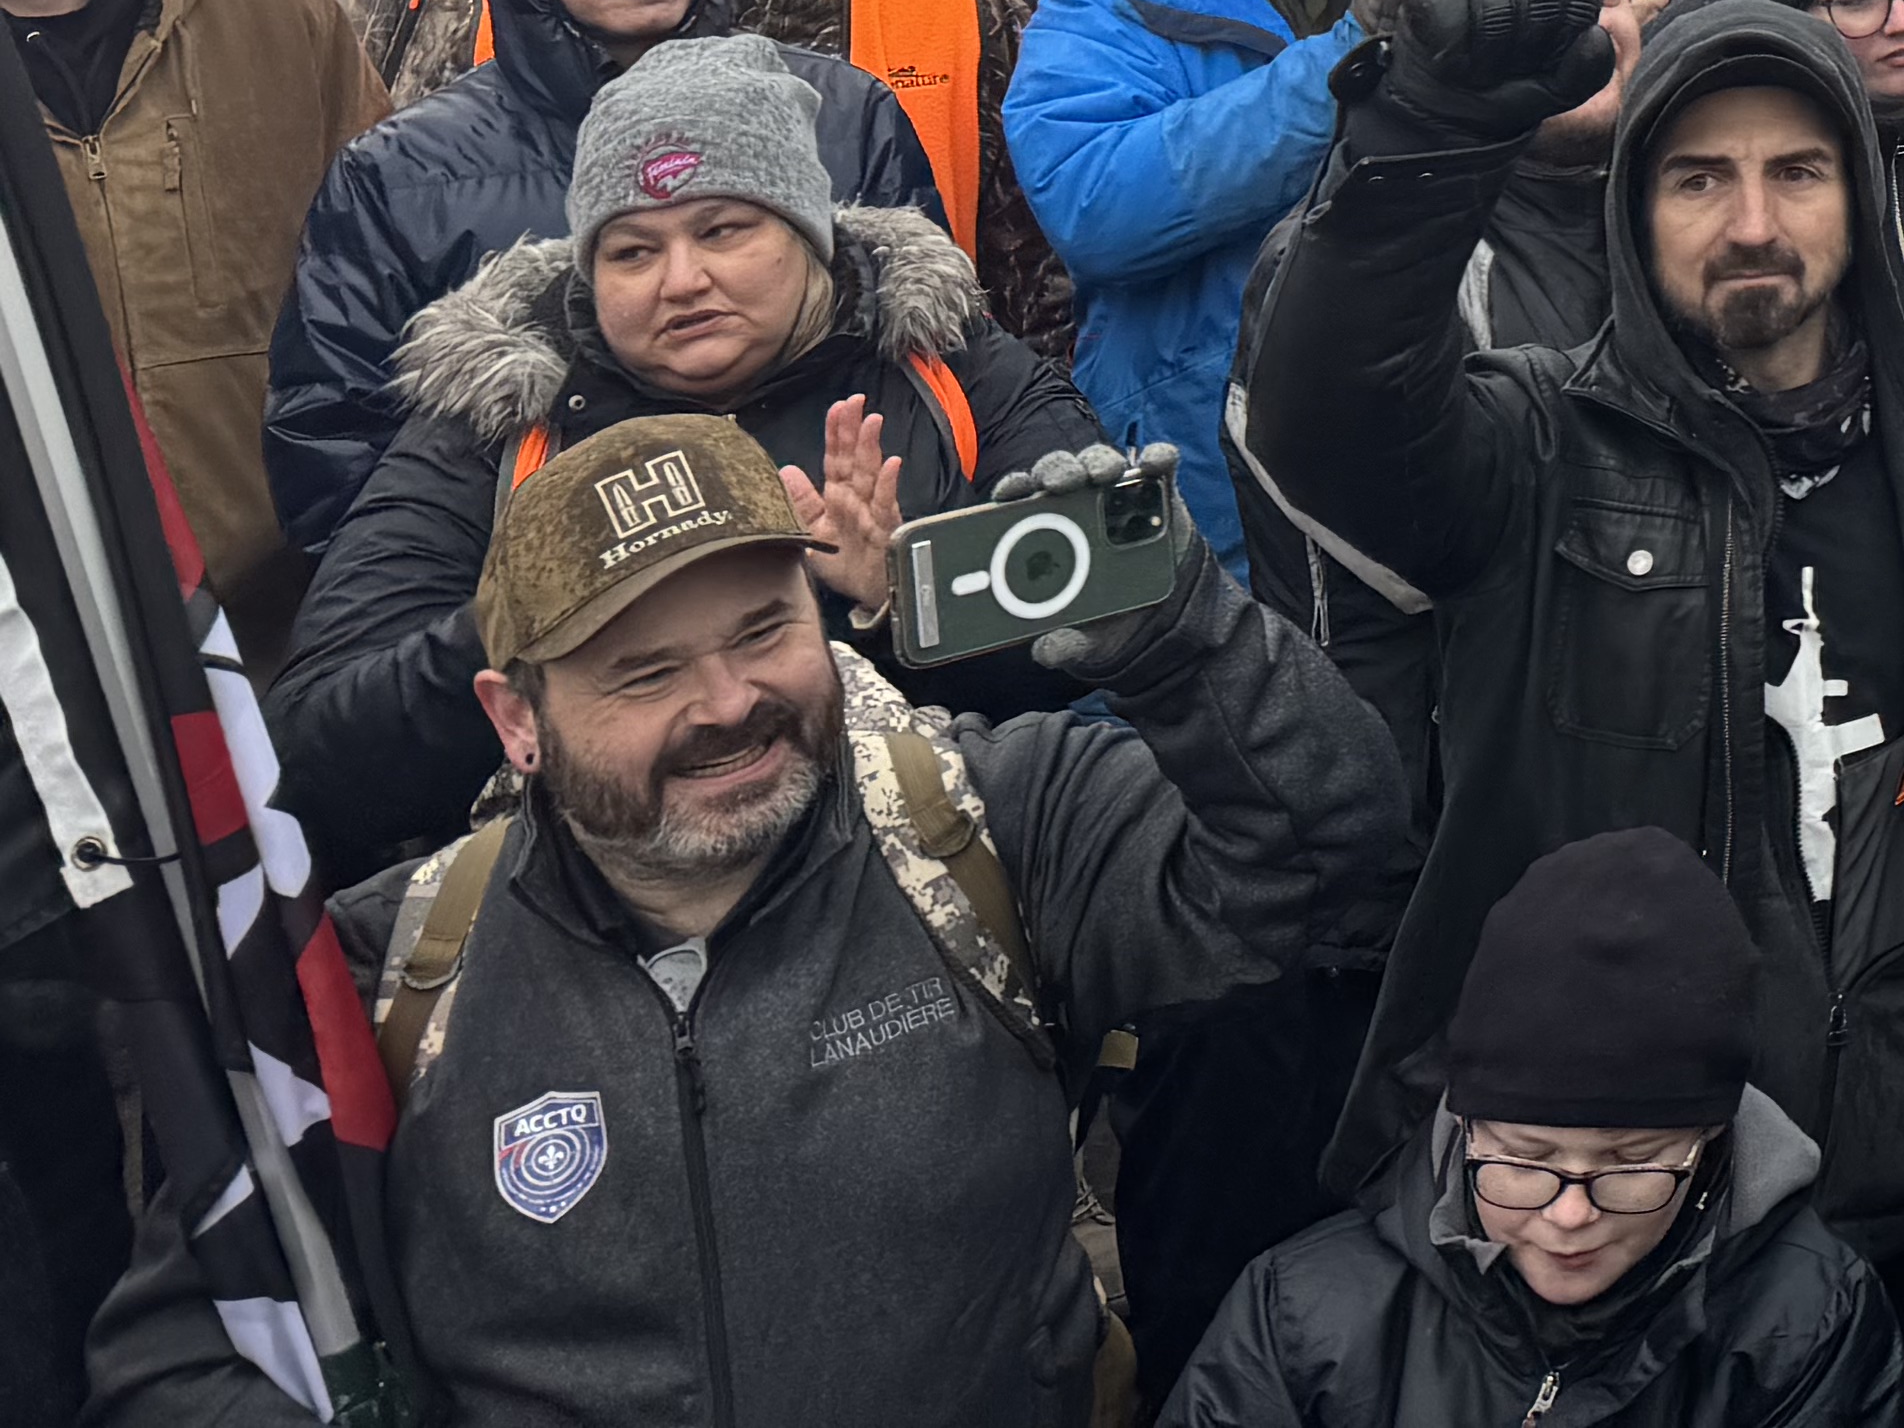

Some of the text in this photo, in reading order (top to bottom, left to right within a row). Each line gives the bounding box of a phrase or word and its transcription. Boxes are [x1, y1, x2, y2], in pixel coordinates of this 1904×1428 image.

[600, 508, 730, 571] Hornady
[810, 995, 903, 1043] CLUB DE
[810, 993, 955, 1069] LANAUDIÈRE
[514, 1102, 588, 1138] ACCTQ
